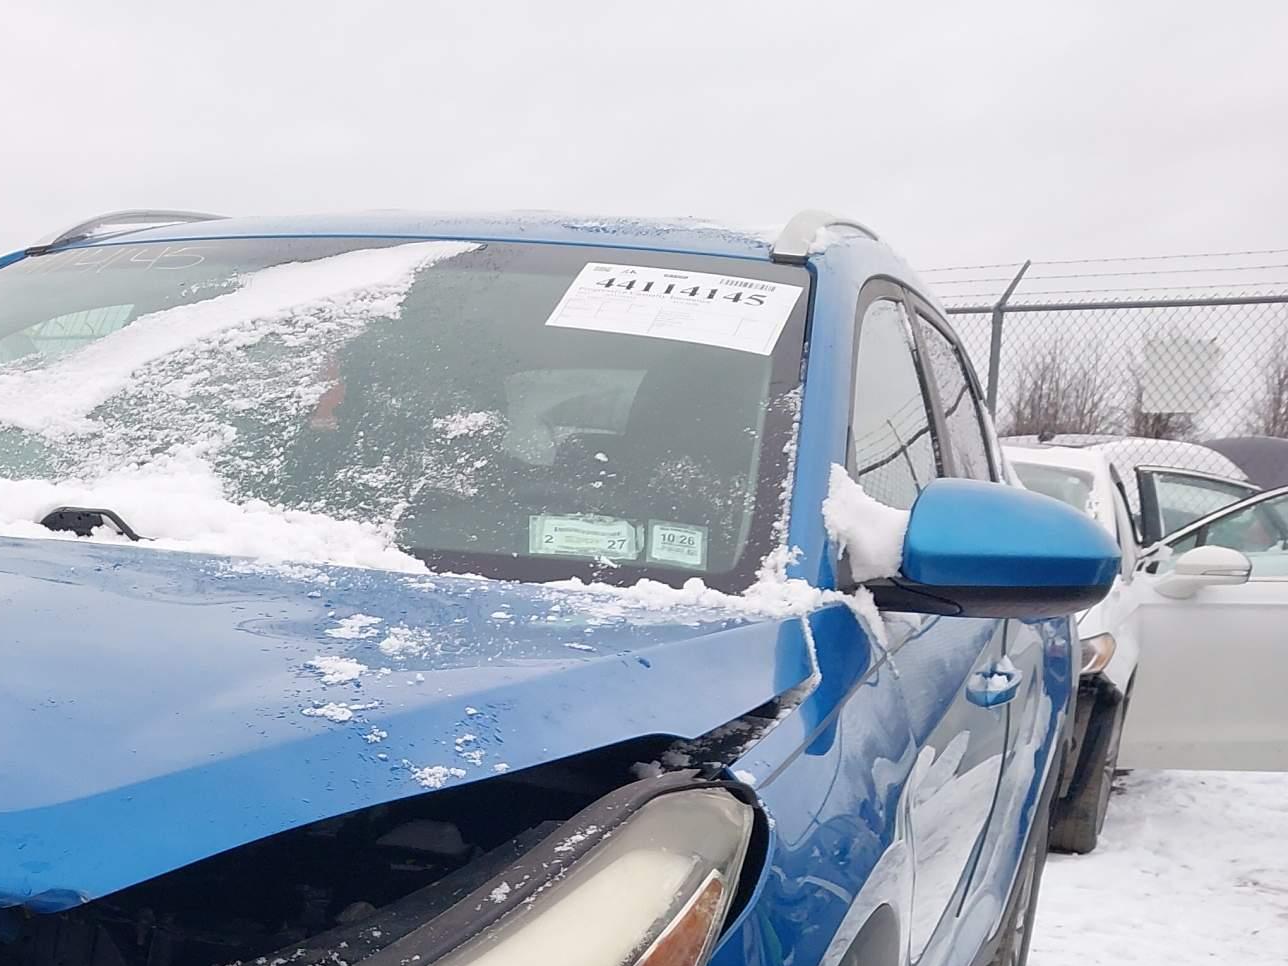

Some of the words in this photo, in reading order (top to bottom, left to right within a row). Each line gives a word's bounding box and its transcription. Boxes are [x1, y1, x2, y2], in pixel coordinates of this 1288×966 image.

[596, 277, 768, 307] 44114145
[544, 534, 554, 544] 2
[607, 538, 627, 551] 27
[661, 533, 675, 543] 10
[679, 535, 695, 546] 26
